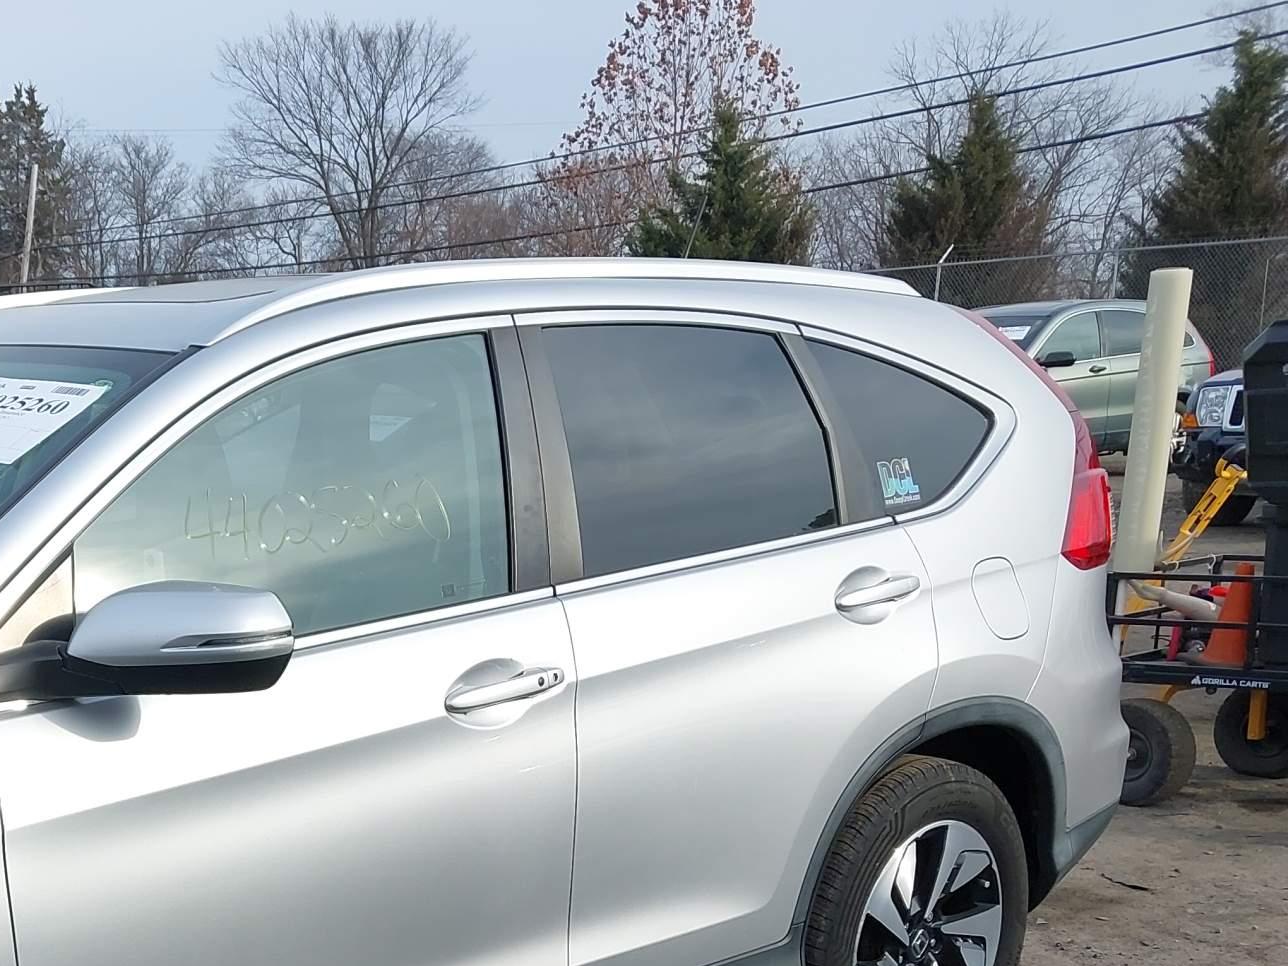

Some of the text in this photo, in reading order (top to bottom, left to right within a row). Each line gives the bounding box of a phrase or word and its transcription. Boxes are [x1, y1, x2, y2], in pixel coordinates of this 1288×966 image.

[876, 457, 920, 498] DCL
[184, 475, 452, 560] 44025260
[1201, 677, 1269, 689] GORILLA CARTS
